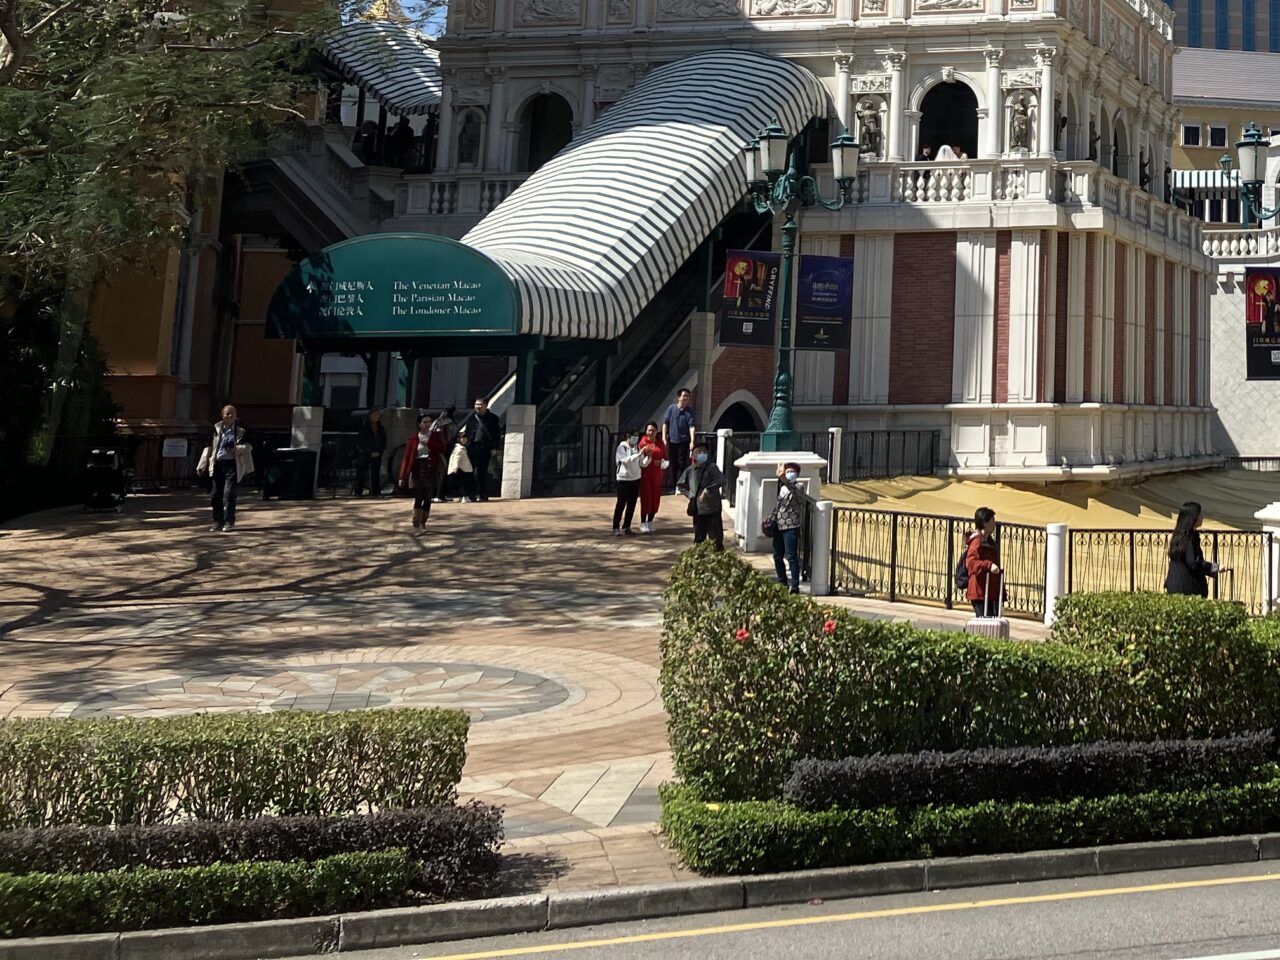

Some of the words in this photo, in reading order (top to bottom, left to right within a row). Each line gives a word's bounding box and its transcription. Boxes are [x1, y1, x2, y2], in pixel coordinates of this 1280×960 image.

[393, 280, 410, 290] The
[412, 280, 450, 290] Venetian
[453, 280, 481, 289] Macao
[392, 293, 409, 302] The
[411, 293, 445, 302] Parisian
[448, 292, 476, 302] Macao
[392, 305, 408, 315] The
[410, 305, 451, 315] Londoner
[453, 305, 481, 314] Macao
